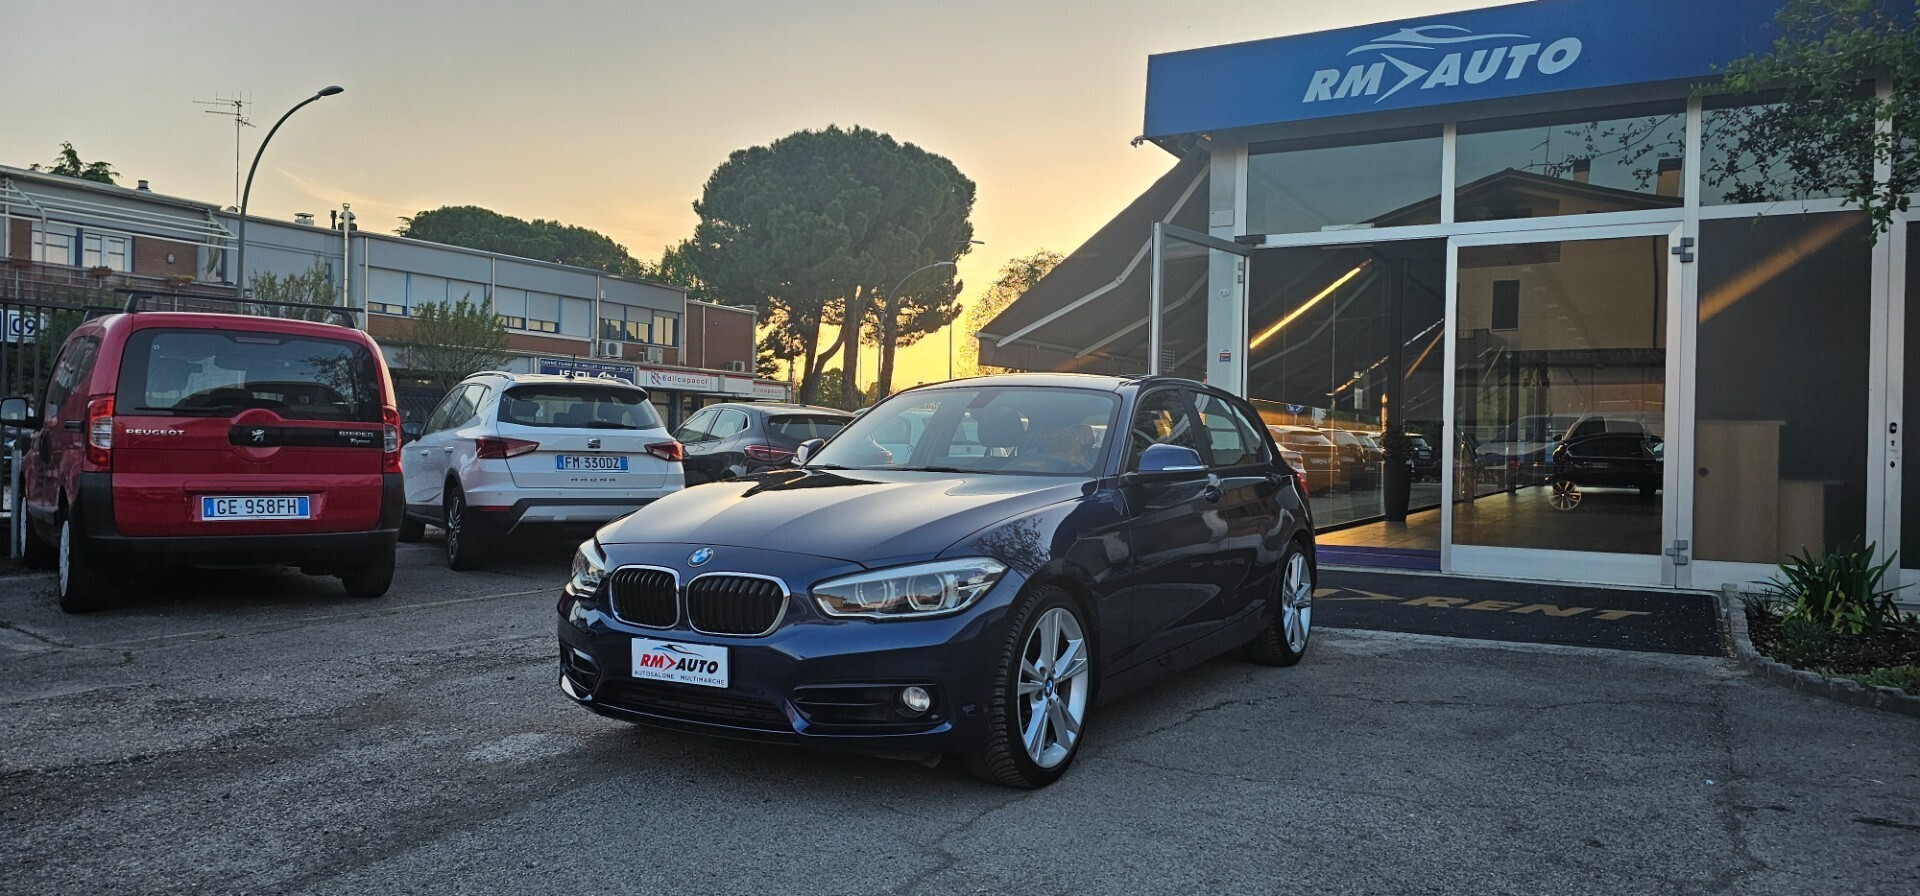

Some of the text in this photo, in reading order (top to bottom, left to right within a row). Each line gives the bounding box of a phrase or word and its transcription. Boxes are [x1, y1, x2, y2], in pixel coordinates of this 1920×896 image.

[1420, 36, 1583, 90] AUTO
[662, 375, 708, 384] Edilcapacci
[125, 428, 185, 436] PEUGEOT
[338, 430, 374, 438] BIPPER
[565, 457, 620, 469] FM 330DZ
[216, 499, 297, 515] GE 958FH
[1400, 595, 1653, 621] RENT
[675, 657, 719, 675] AUTO
[634, 670, 725, 686] AUTOSALONE MULTIMARCHE
